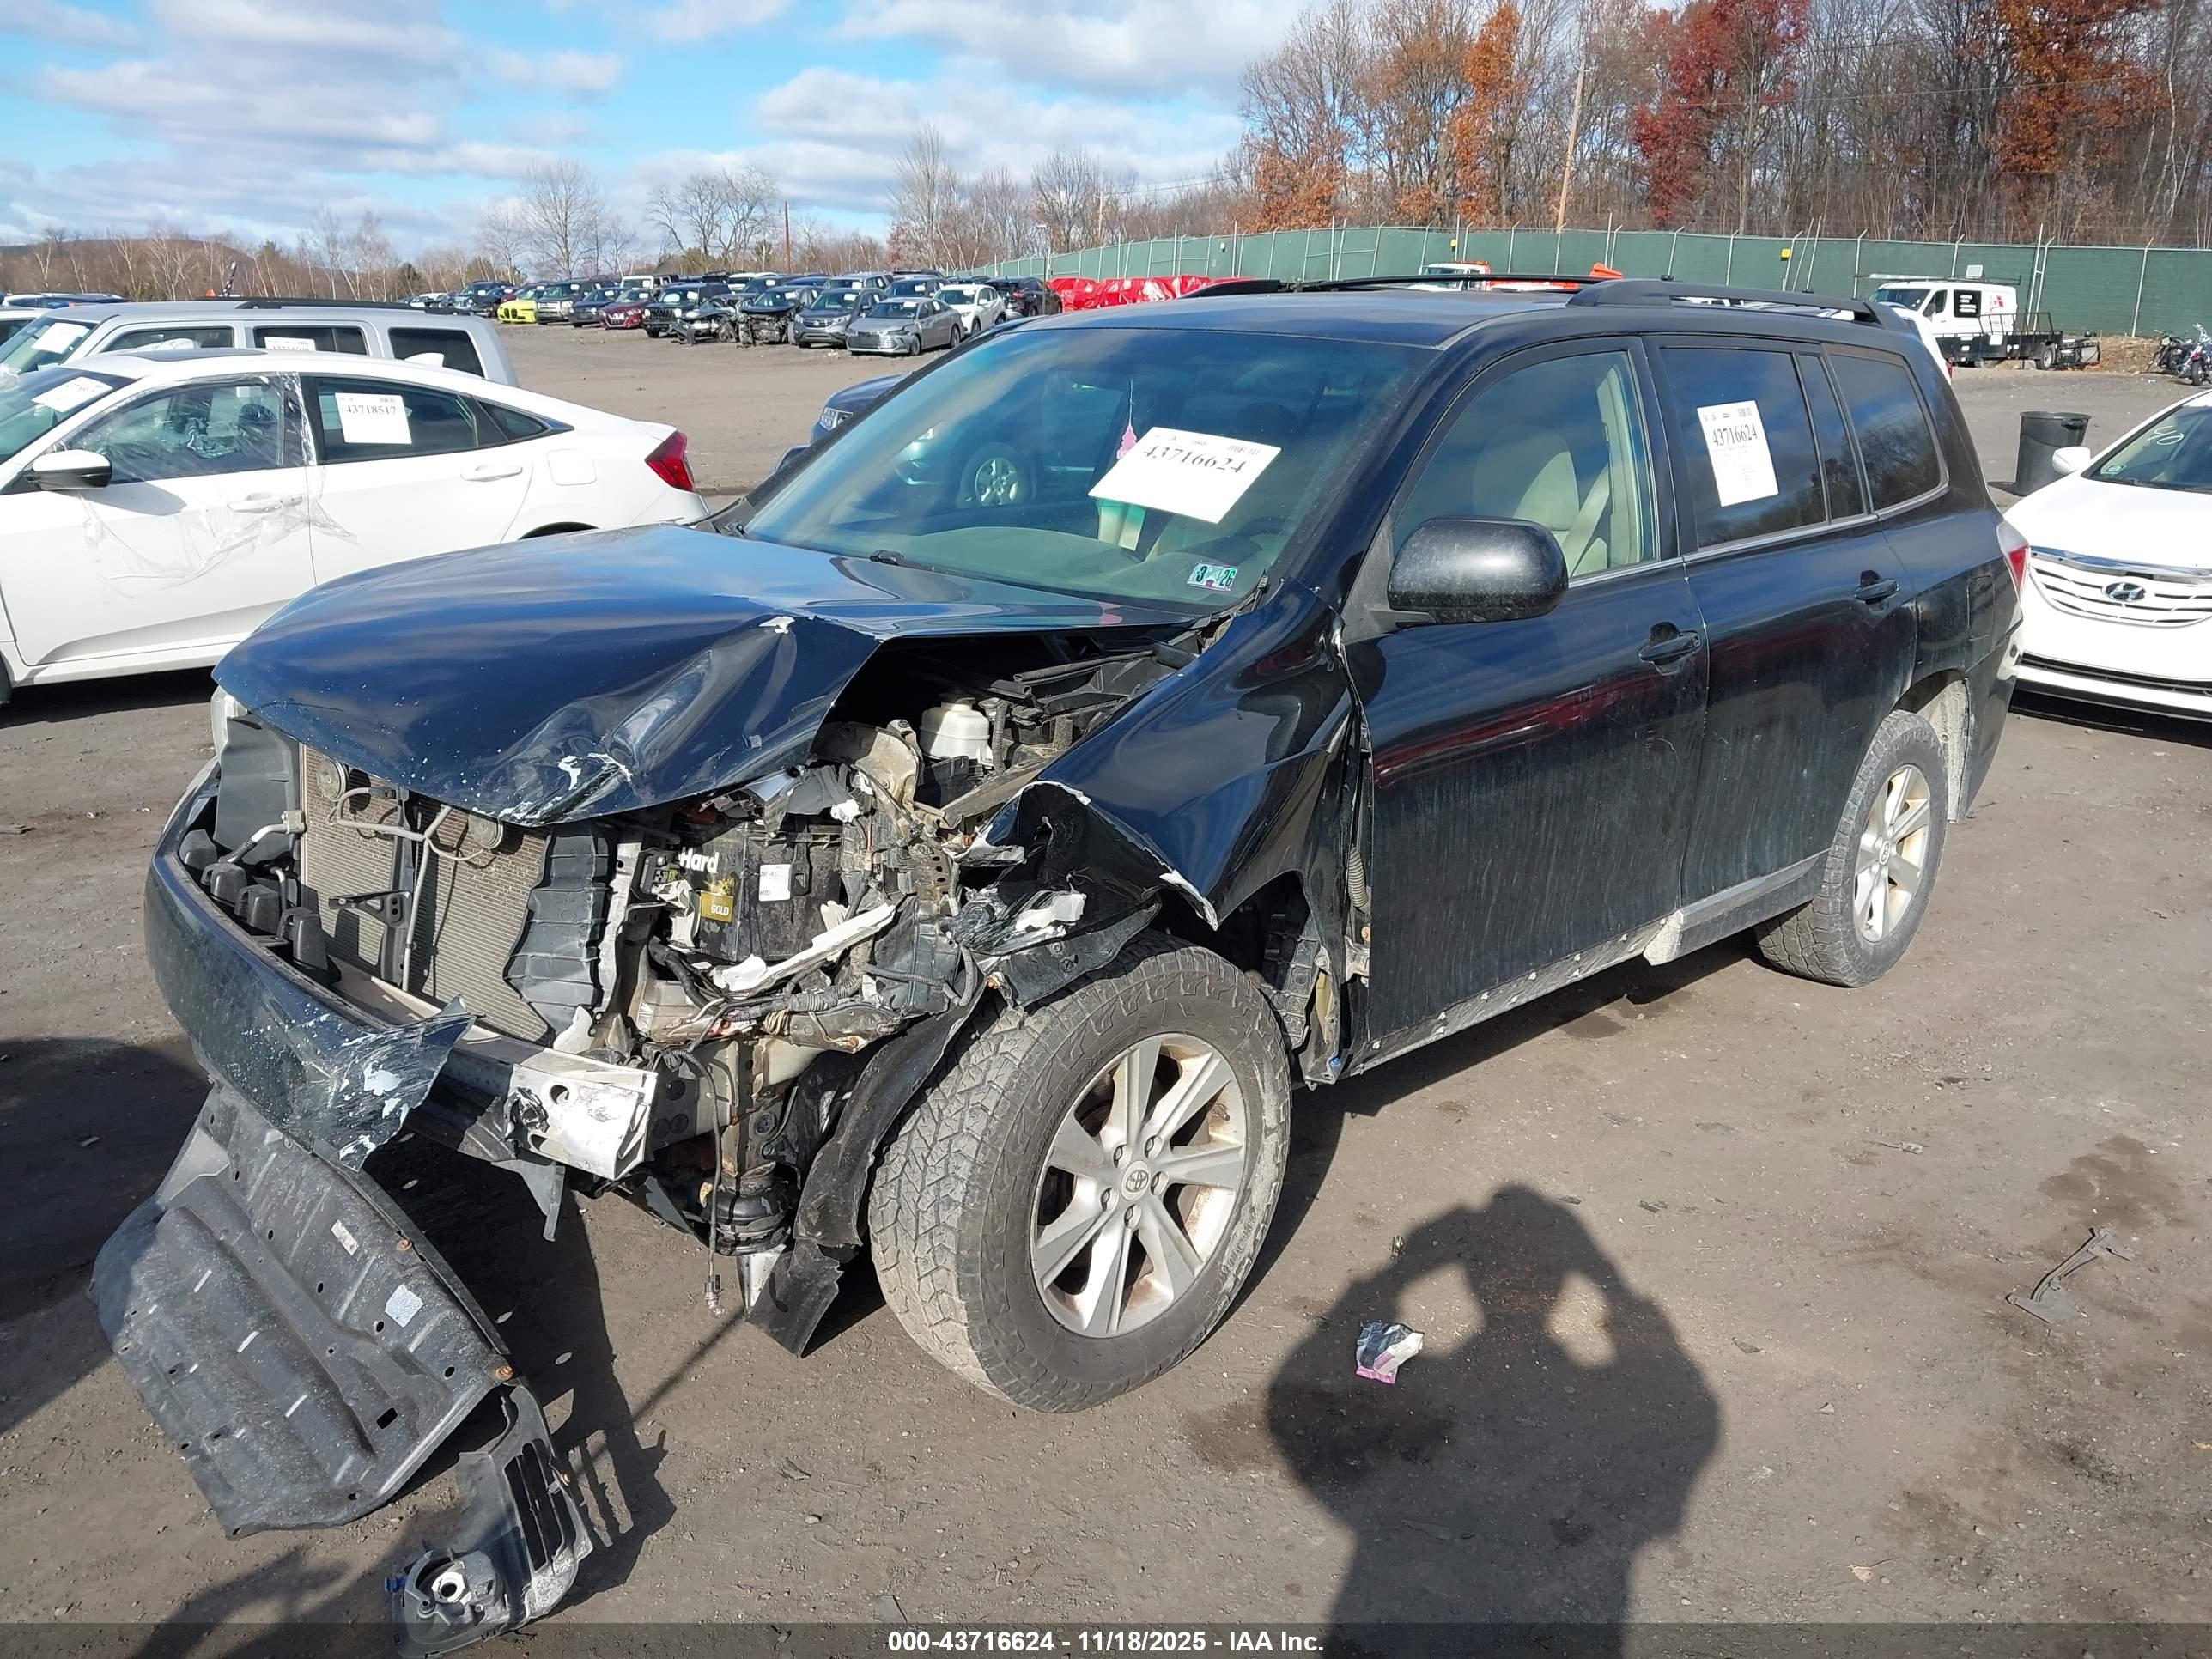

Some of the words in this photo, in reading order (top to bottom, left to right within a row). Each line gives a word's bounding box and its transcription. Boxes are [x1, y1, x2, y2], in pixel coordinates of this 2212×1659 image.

[345, 404, 396, 415] 43718517
[1712, 424, 1758, 446] 43716624
[1143, 445, 1247, 473] 43716624
[711, 904, 730, 916] GOLD
